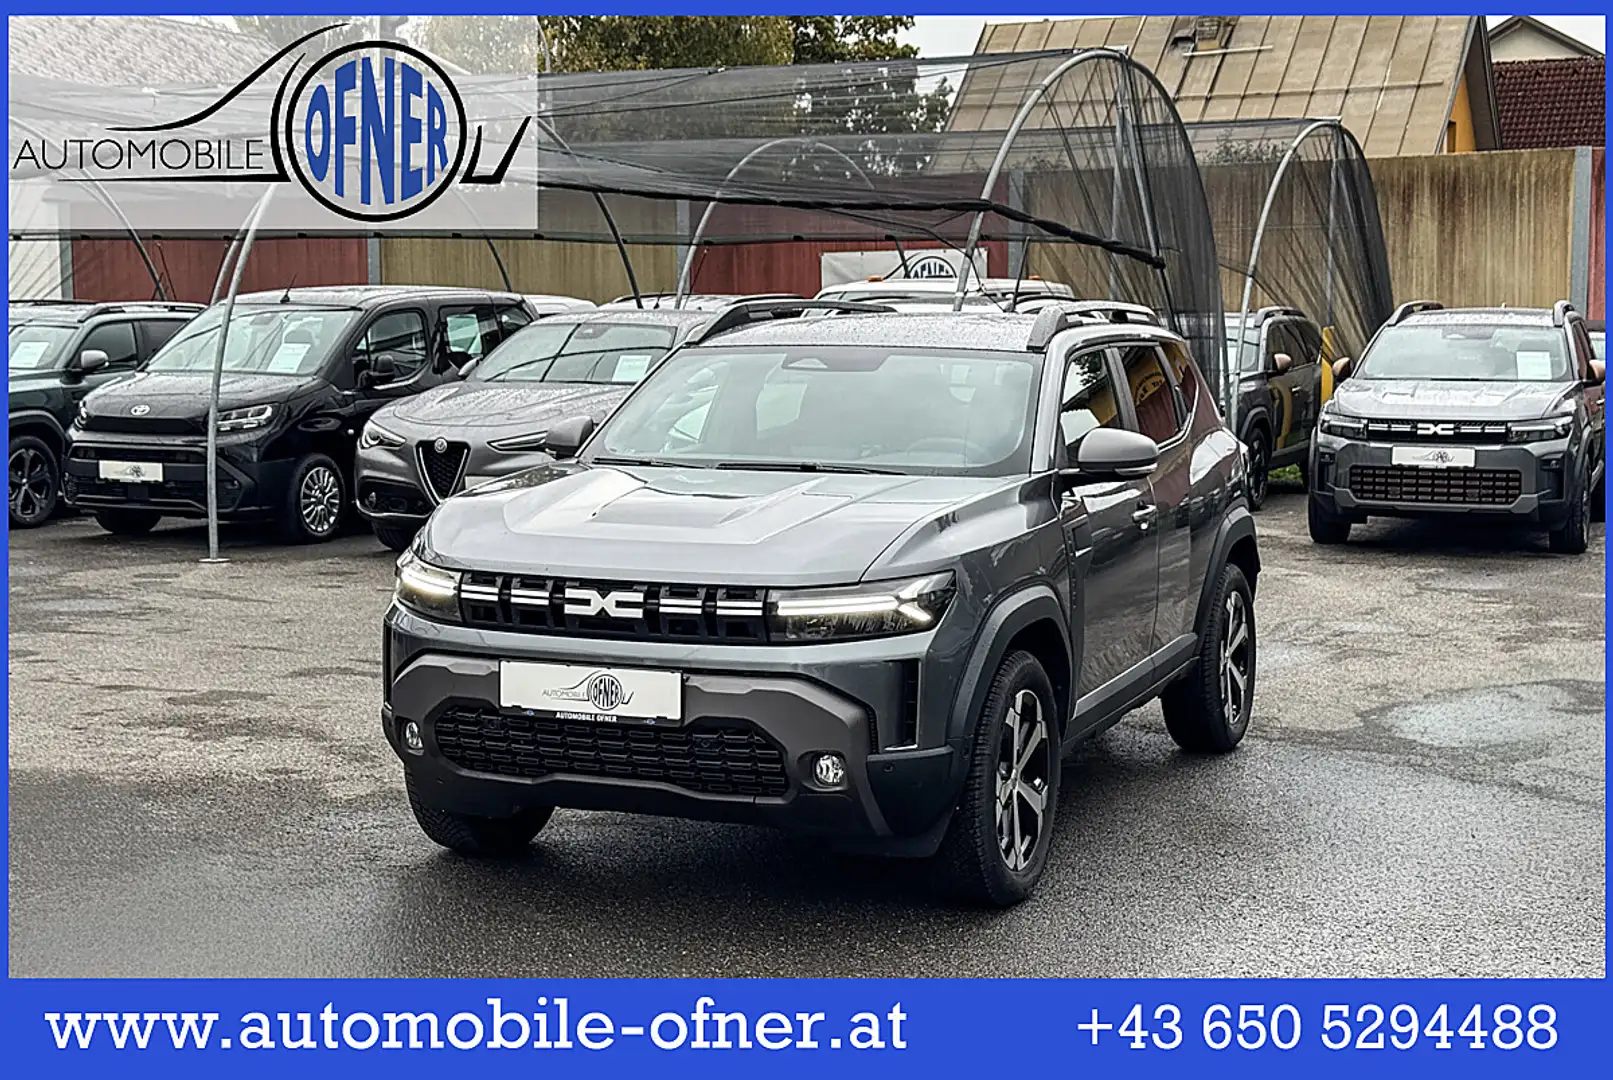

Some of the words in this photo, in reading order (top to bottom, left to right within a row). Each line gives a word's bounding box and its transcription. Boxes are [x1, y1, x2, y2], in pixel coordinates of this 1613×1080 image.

[592, 677, 620, 708] OFNER
[555, 711, 595, 721] AUTOMOBILE
[596, 714, 618, 723] OFNER
